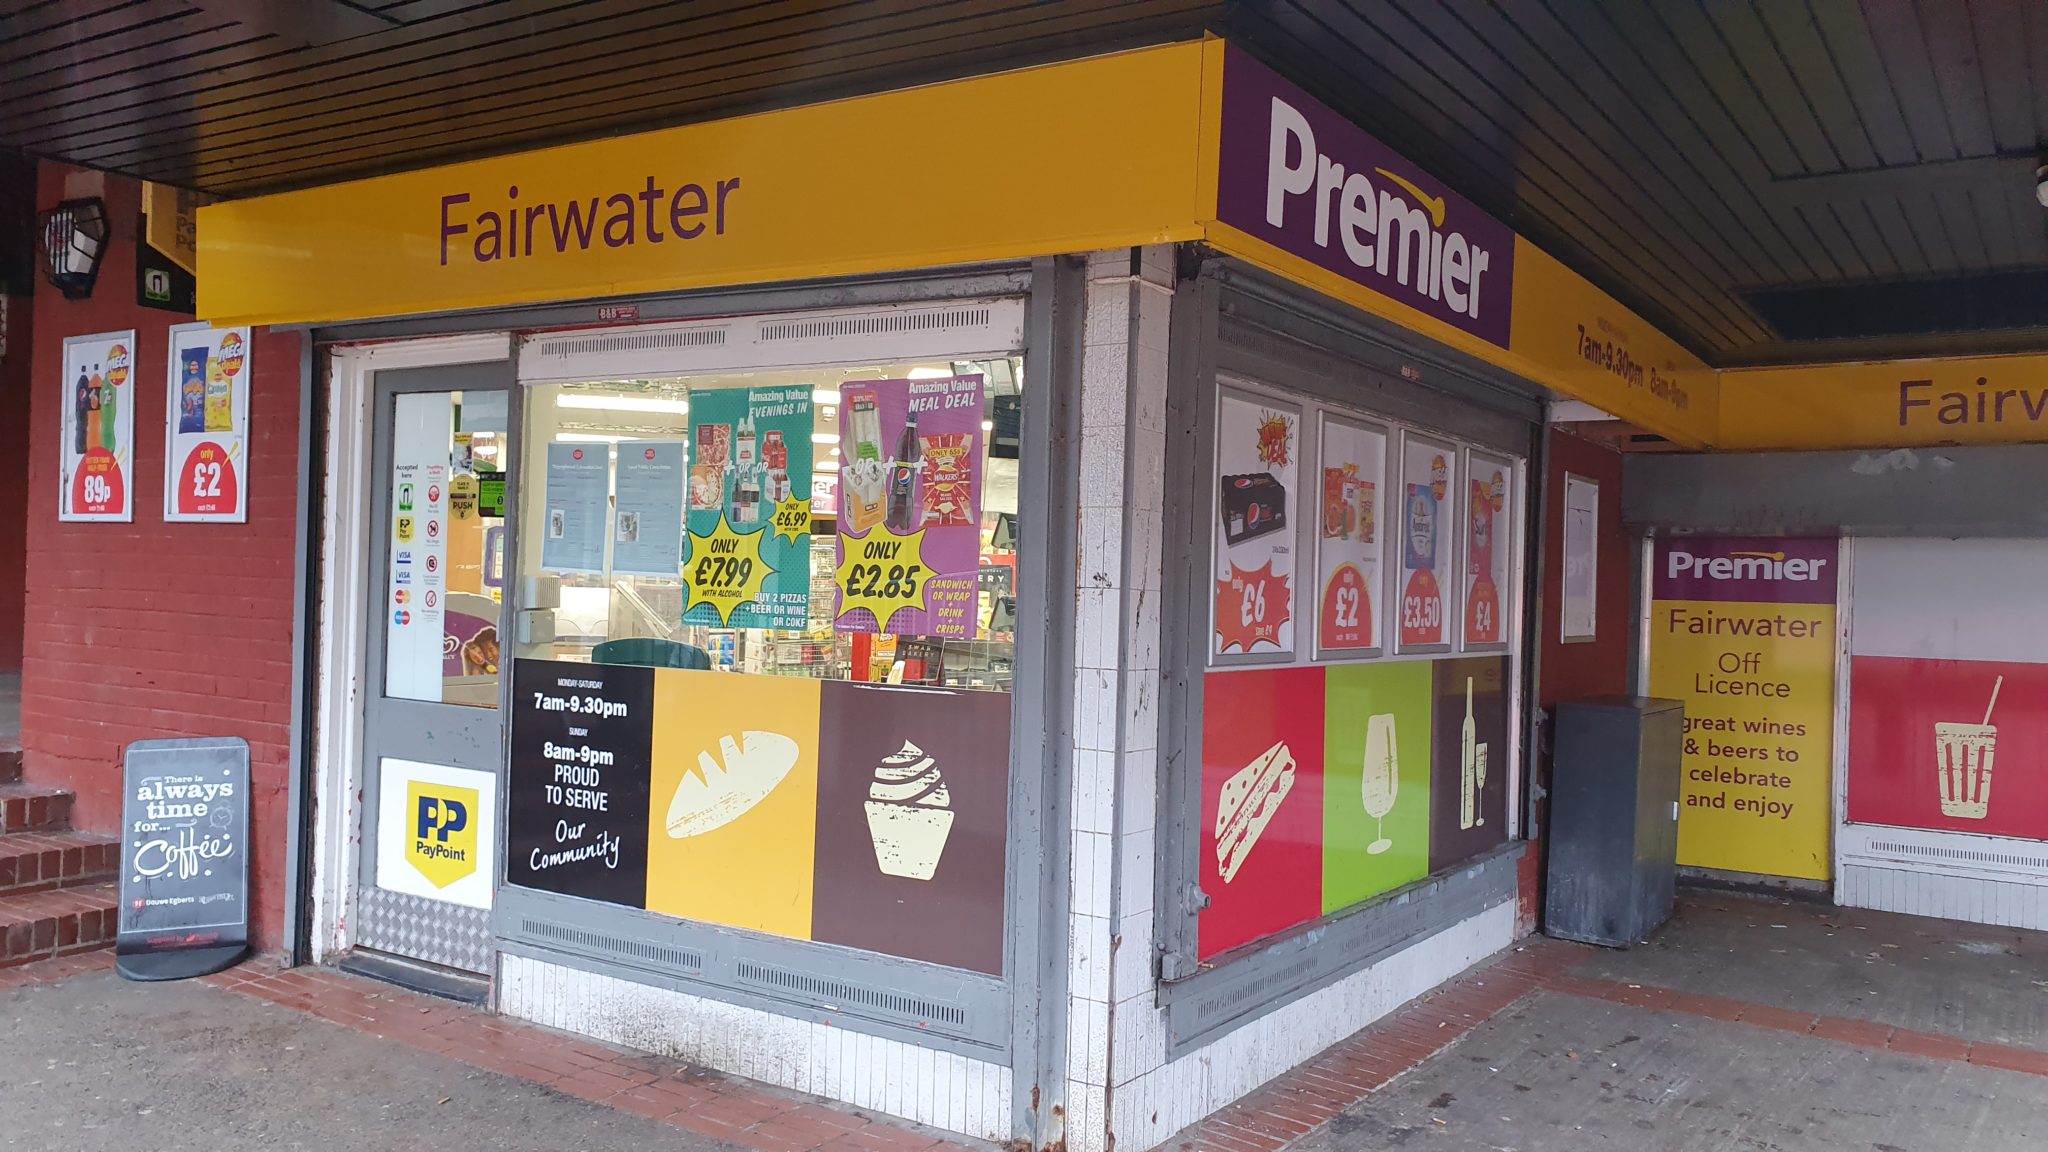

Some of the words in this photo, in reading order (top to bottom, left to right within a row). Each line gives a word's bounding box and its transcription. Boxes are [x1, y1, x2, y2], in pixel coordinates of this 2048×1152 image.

[1267, 95, 1489, 319] Premier
[440, 175, 740, 266] Fairwater
[1578, 323, 1643, 387] 7am-9.30pm
[749, 391, 784, 402] Amazing
[786, 389, 808, 400] Value
[909, 382, 949, 395] Amazing
[951, 380, 977, 392] Value
[749, 404, 794, 418] EVENINGS
[797, 402, 808, 413] IN
[908, 397, 940, 413] MEAL
[944, 393, 975, 408] DEAL
[200, 448, 214, 461] only
[739, 463, 750, 474] OR
[756, 462, 769, 473] OR
[856, 458, 875, 474] OR
[84, 475, 111, 503] 89p
[193, 462, 221, 497] £2
[453, 502, 473, 510] PUSH
[776, 512, 807, 527] £6.99
[711, 539, 739, 554] ONLY
[863, 541, 901, 560] ONLY
[695, 556, 752, 588] £7.99
[1668, 551, 1827, 581] Premier
[846, 564, 921, 598] £2.85
[930, 579, 973, 590] SANDWICH
[702, 589, 717, 597] WITH
[718, 590, 743, 598] ALCOHOL
[754, 592, 770, 602] BUY
[773, 593, 778, 602] 2
[780, 593, 807, 604] PIZZAS
[932, 591, 943, 600] OR
[946, 592, 970, 602] WRAP
[1241, 580, 1266, 627] £6
[774, 605, 784, 615] OR
[786, 606, 806, 616] WINE
[938, 607, 964, 618] DRINK
[1335, 587, 1359, 627] £2
[1404, 596, 1440, 628] £3.50
[1476, 601, 1491, 632] £4
[773, 617, 784, 627] OR
[936, 624, 965, 634] CRISPS
[1669, 608, 1822, 638] Fairwater
[1718, 652, 1761, 674] Off
[557, 678, 603, 689] MONDAY-SATURDAY
[1695, 672, 1790, 697] Licence
[534, 692, 628, 718] 7am-9.30pm
[569, 727, 588, 736] SUNDAY
[1683, 717, 1736, 734] great
[1743, 717, 1806, 736] wines
[543, 741, 614, 766] 8am-9pm
[1684, 738, 1700, 755] &
[1708, 738, 1769, 760] beers
[1776, 746, 1799, 762] to
[164, 776, 193, 784] There
[554, 764, 600, 787] PROUD
[1689, 765, 1792, 788] celebrate
[137, 782, 233, 803] always
[545, 785, 562, 805] TO
[565, 789, 608, 811] SERVE
[146, 802, 208, 819] time
[1686, 791, 1726, 809] and
[1734, 796, 1793, 819] enjoy
[133, 820, 171, 832] for...
[555, 819, 585, 843] Our
[133, 827, 233, 880] Coffee
[416, 841, 465, 862] PayPoint
[530, 830, 620, 870] Community
[146, 898, 168, 907] Douwe
[169, 897, 195, 906] Egberts
